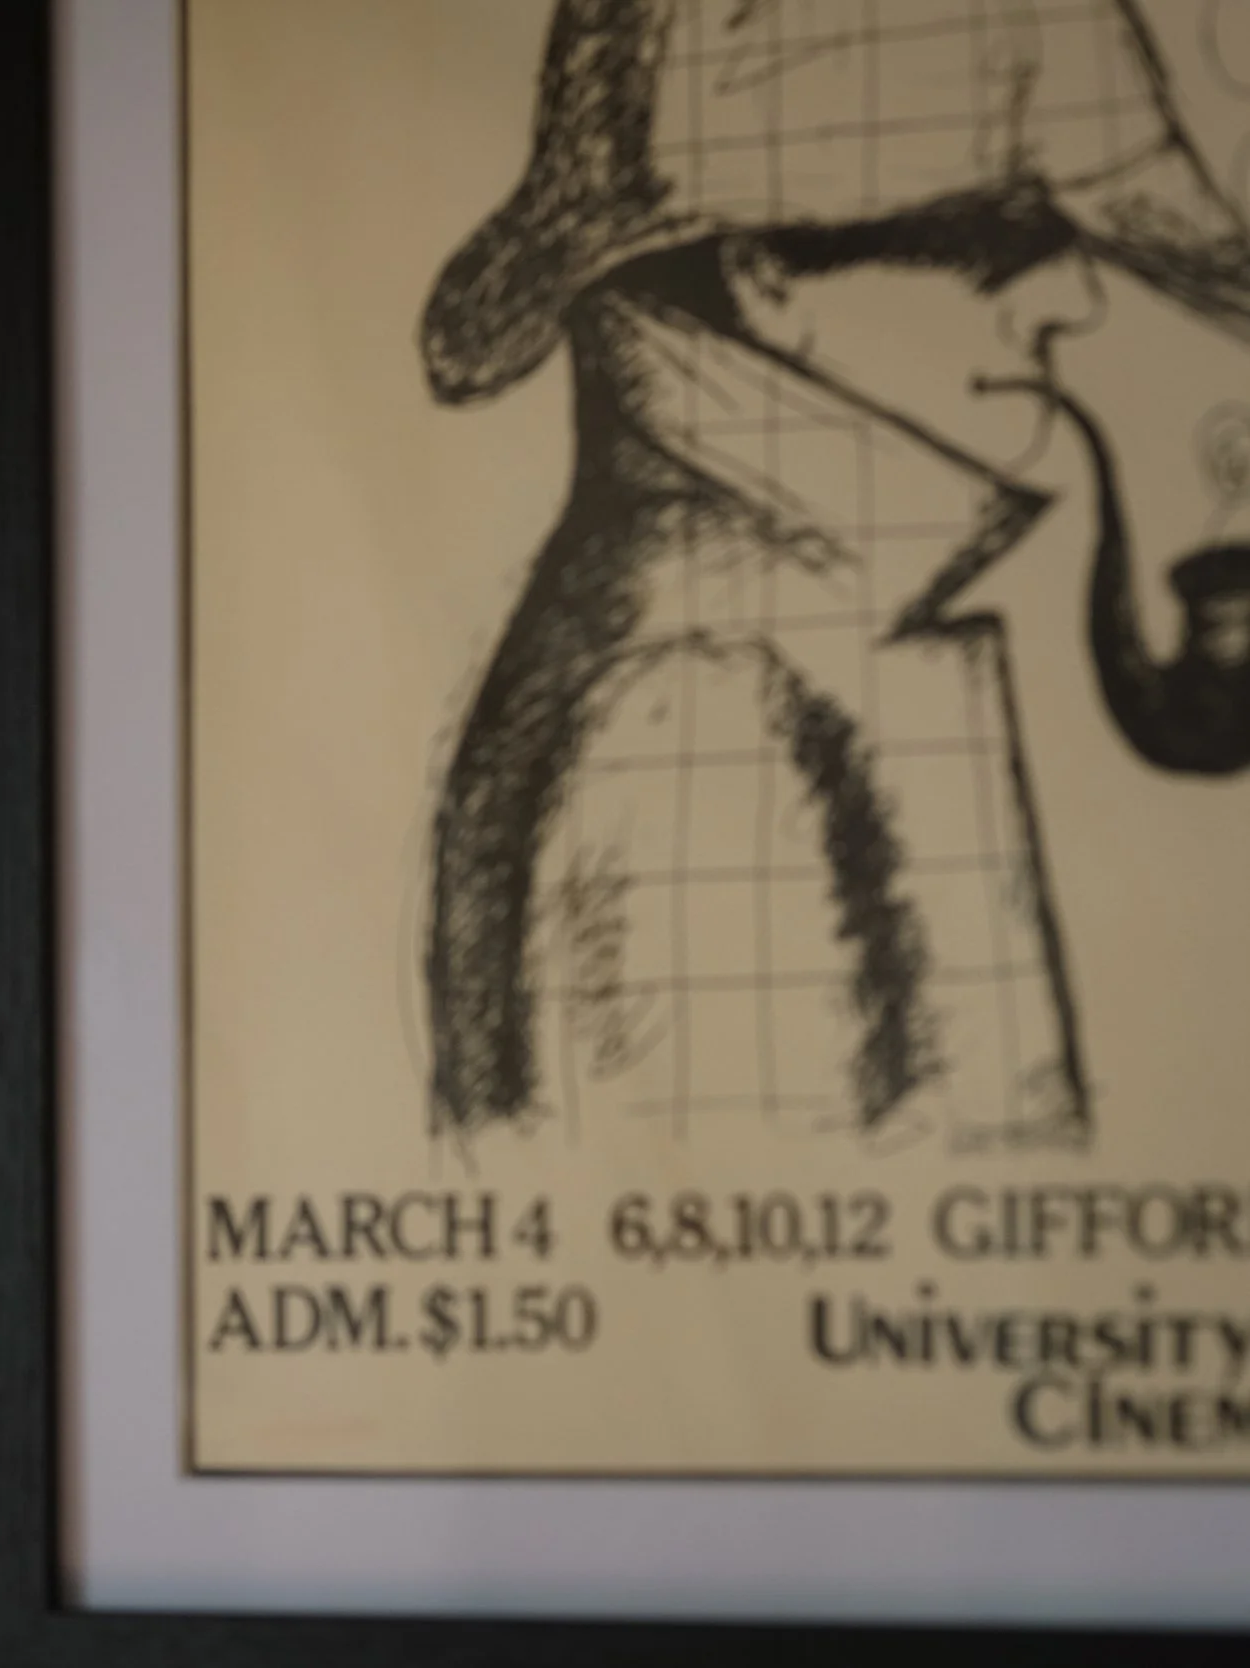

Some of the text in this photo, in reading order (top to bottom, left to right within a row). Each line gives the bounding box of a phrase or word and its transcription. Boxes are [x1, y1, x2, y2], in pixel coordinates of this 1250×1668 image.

[206, 1191, 498, 1262] MARCH
[511, 1194, 558, 1262] 4
[608, 1190, 893, 1272] 6,8,10,12
